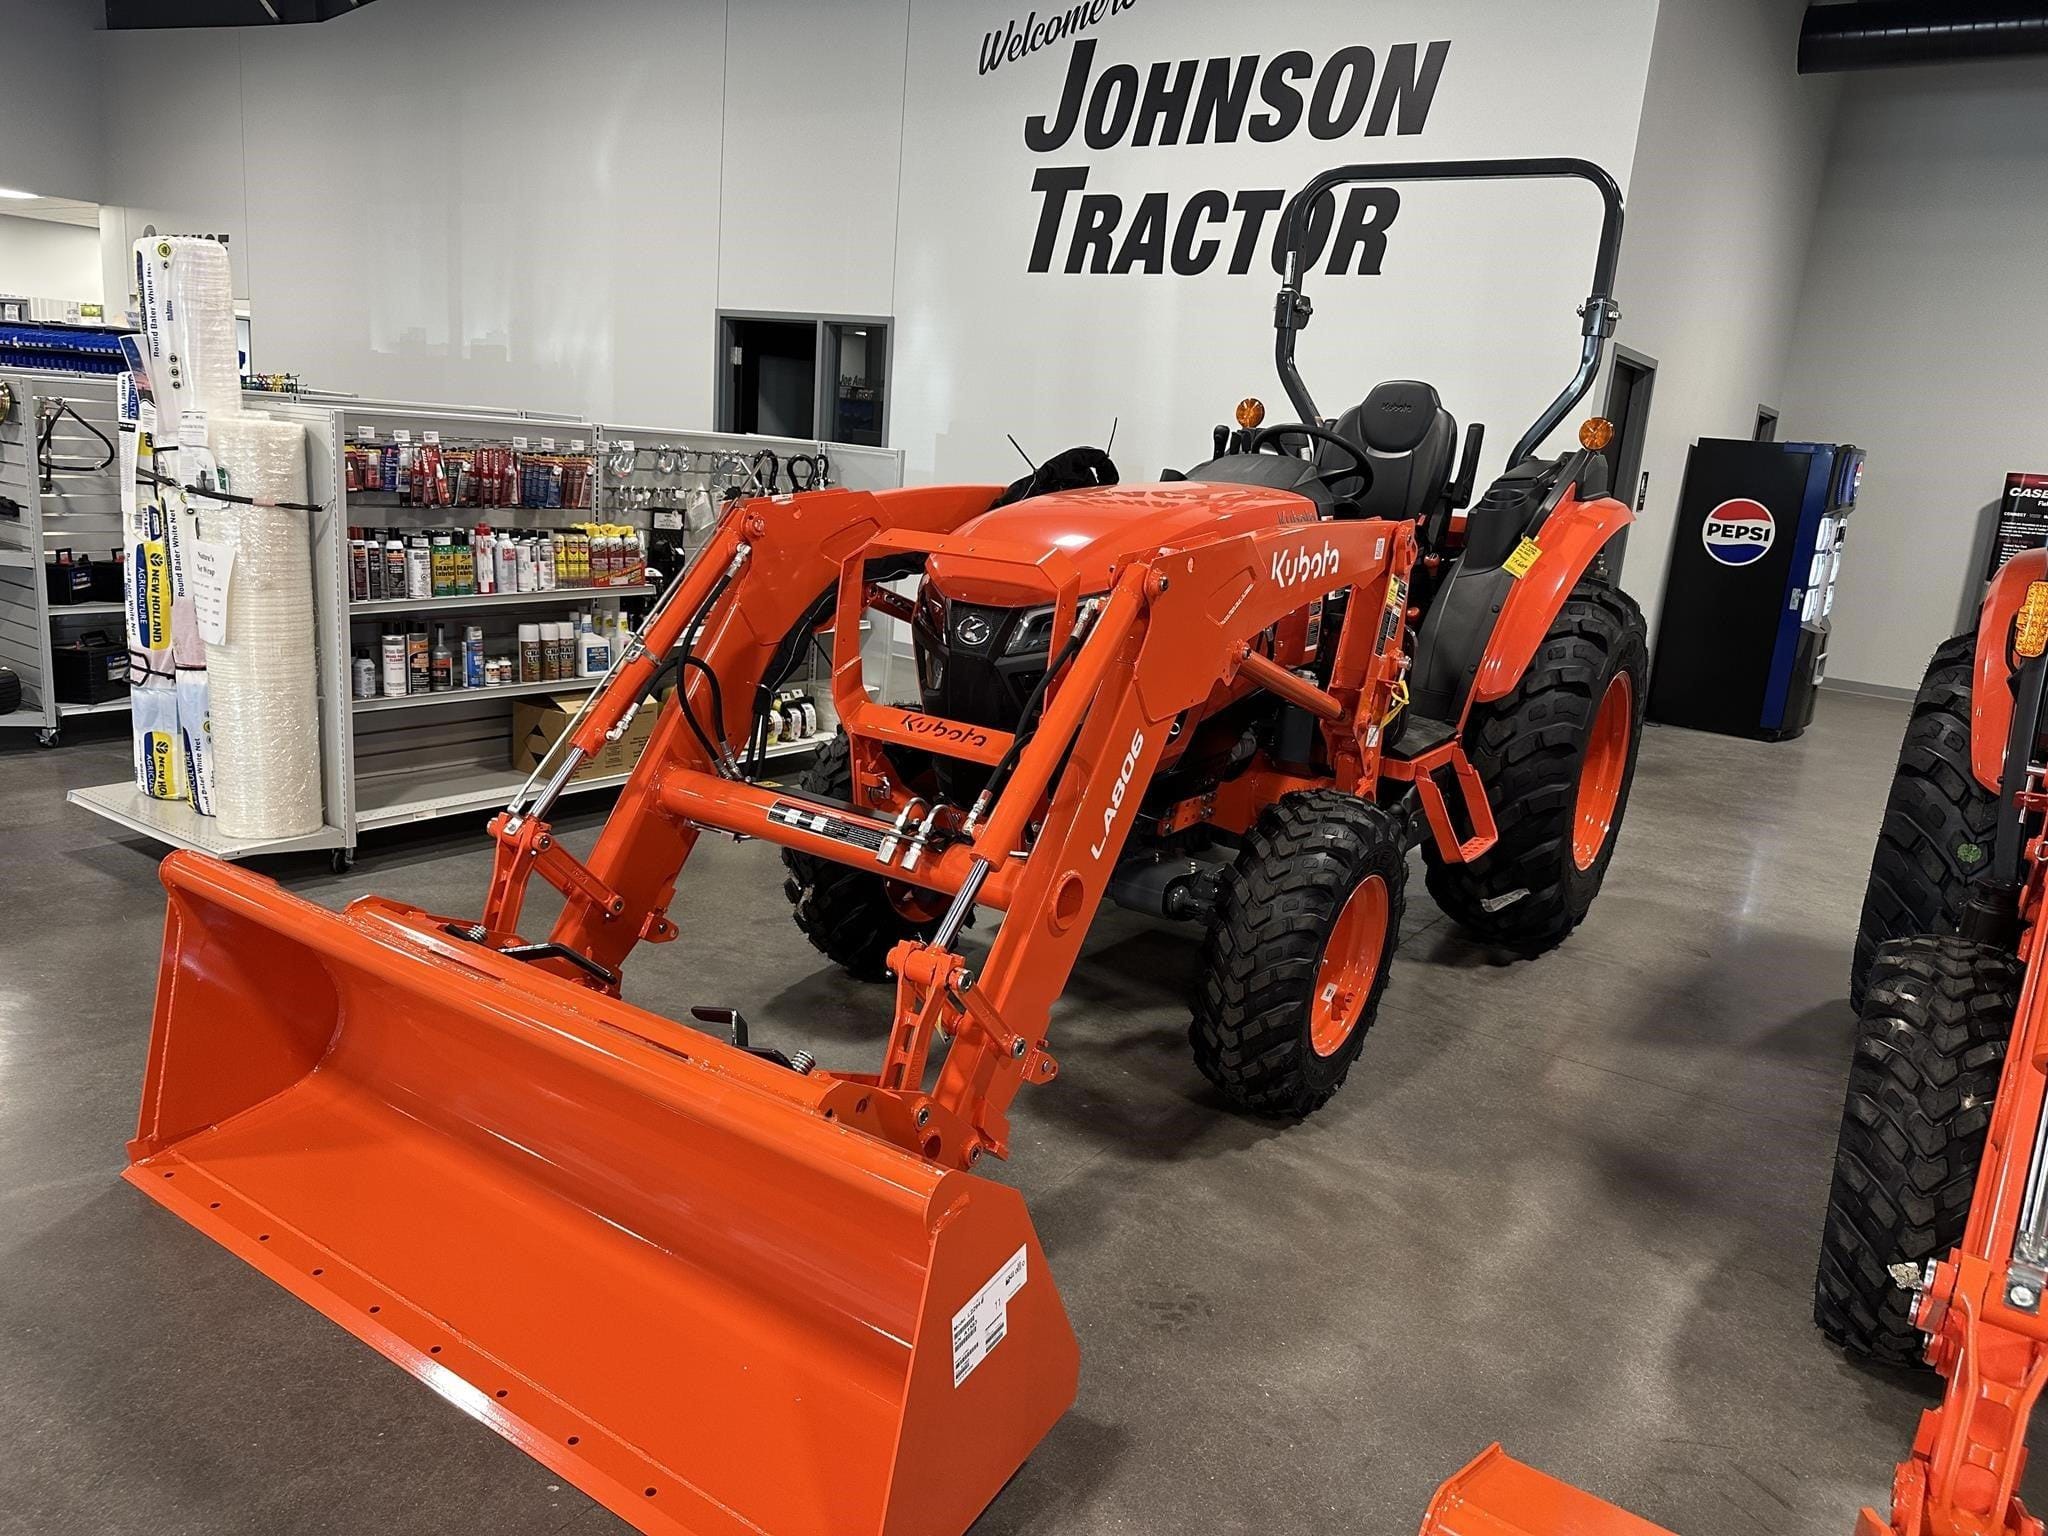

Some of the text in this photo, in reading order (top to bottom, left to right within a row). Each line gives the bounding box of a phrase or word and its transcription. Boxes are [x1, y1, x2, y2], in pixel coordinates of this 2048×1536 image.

[978, 0, 1104, 76] Welcome
[1024, 38, 1453, 153] JOHNSON
[1026, 166, 1401, 276] TRACTOR
[171, 525, 179, 548] White
[1706, 522, 1772, 543] PEPSI
[174, 550, 182, 571] Baler
[1271, 540, 1340, 588] Kubota
[138, 567, 148, 625] AGRICULTURE
[151, 569, 162, 643] NEW HOLLAND
[175, 573, 185, 597] Round
[901, 714, 988, 747] Kubota
[158, 756, 166, 780] NEW
[1091, 728, 1144, 860] LA806
